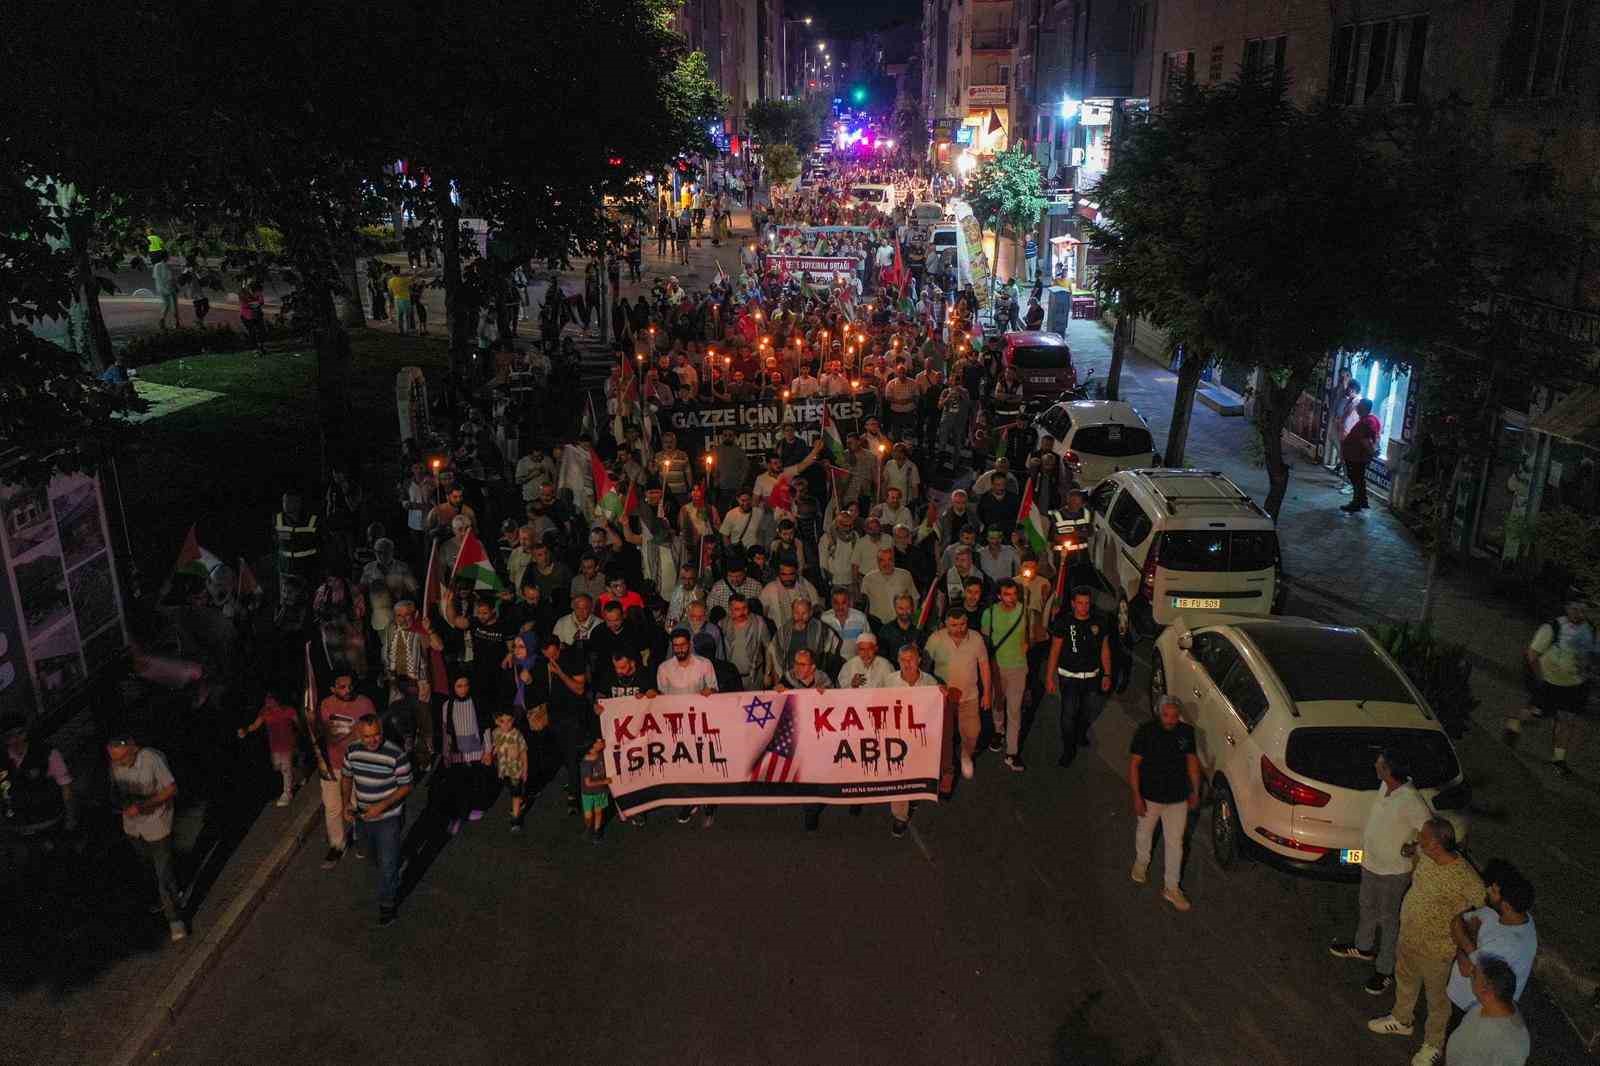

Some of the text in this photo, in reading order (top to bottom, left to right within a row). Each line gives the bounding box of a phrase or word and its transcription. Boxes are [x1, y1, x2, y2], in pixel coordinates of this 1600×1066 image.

[672, 408, 737, 429] GAZZE
[611, 686, 640, 698] FREE
[613, 706, 720, 746] KATİL
[813, 700, 927, 737] KATİL
[612, 737, 727, 777] İSRAİL
[833, 738, 908, 769] ABD
[1350, 851, 1359, 861] 16
